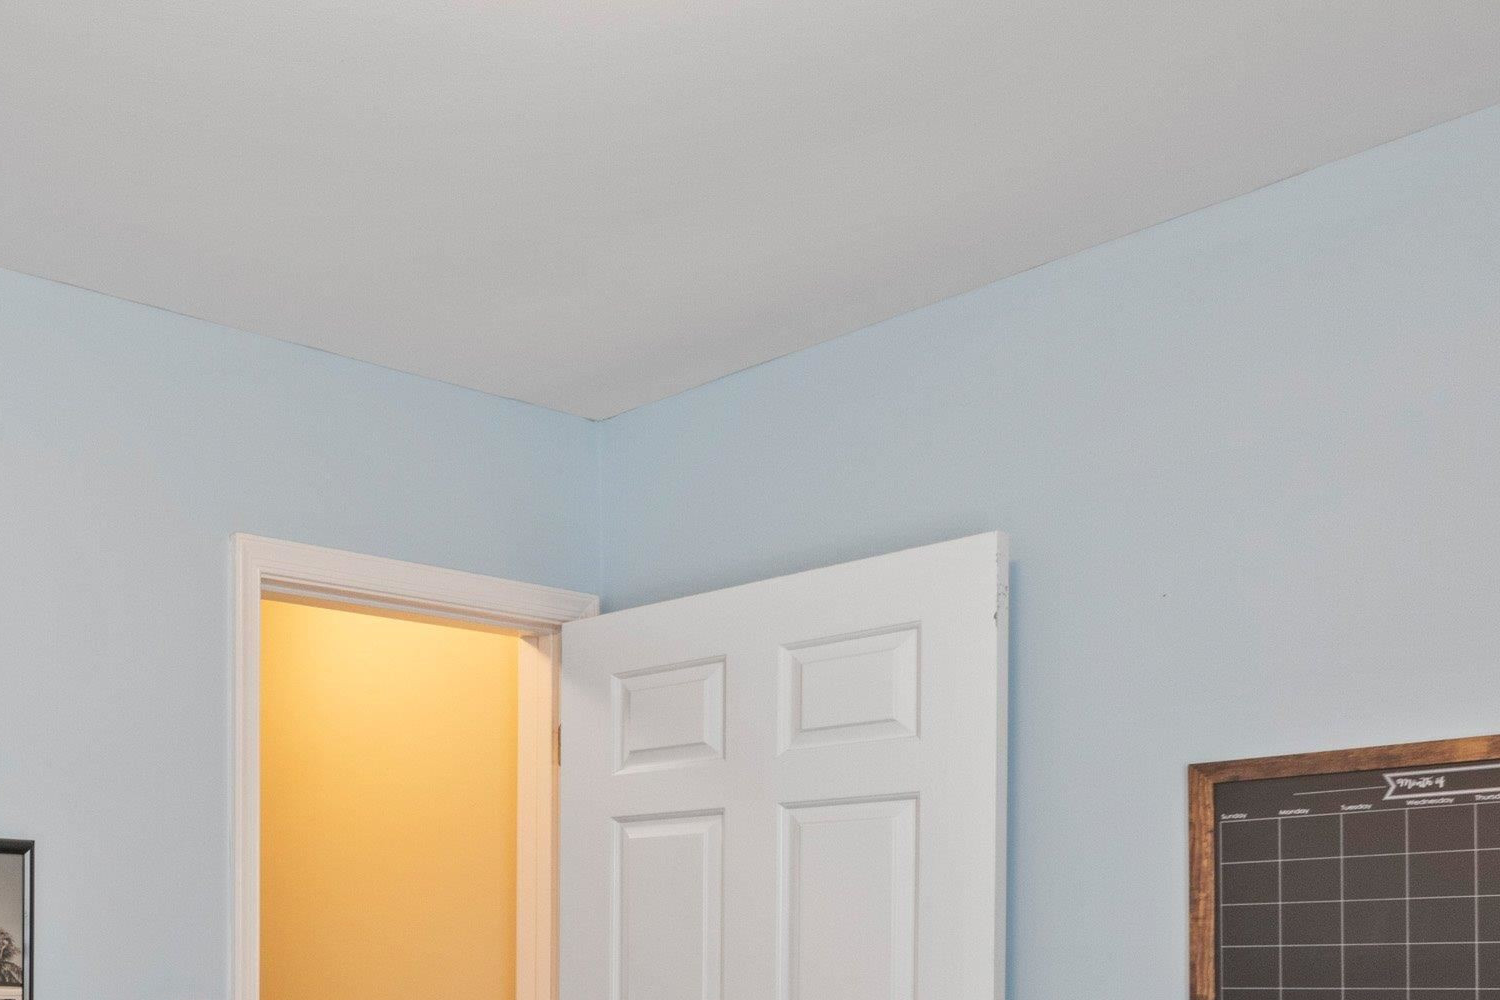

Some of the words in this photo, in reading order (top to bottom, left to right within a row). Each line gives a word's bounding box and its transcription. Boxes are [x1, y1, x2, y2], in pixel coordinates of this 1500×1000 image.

[1220, 812, 1248, 820] Sunday
[1278, 808, 1310, 816] Monday
[1340, 803, 1373, 812] Tuesday
[1406, 798, 1455, 806] Wednesday
